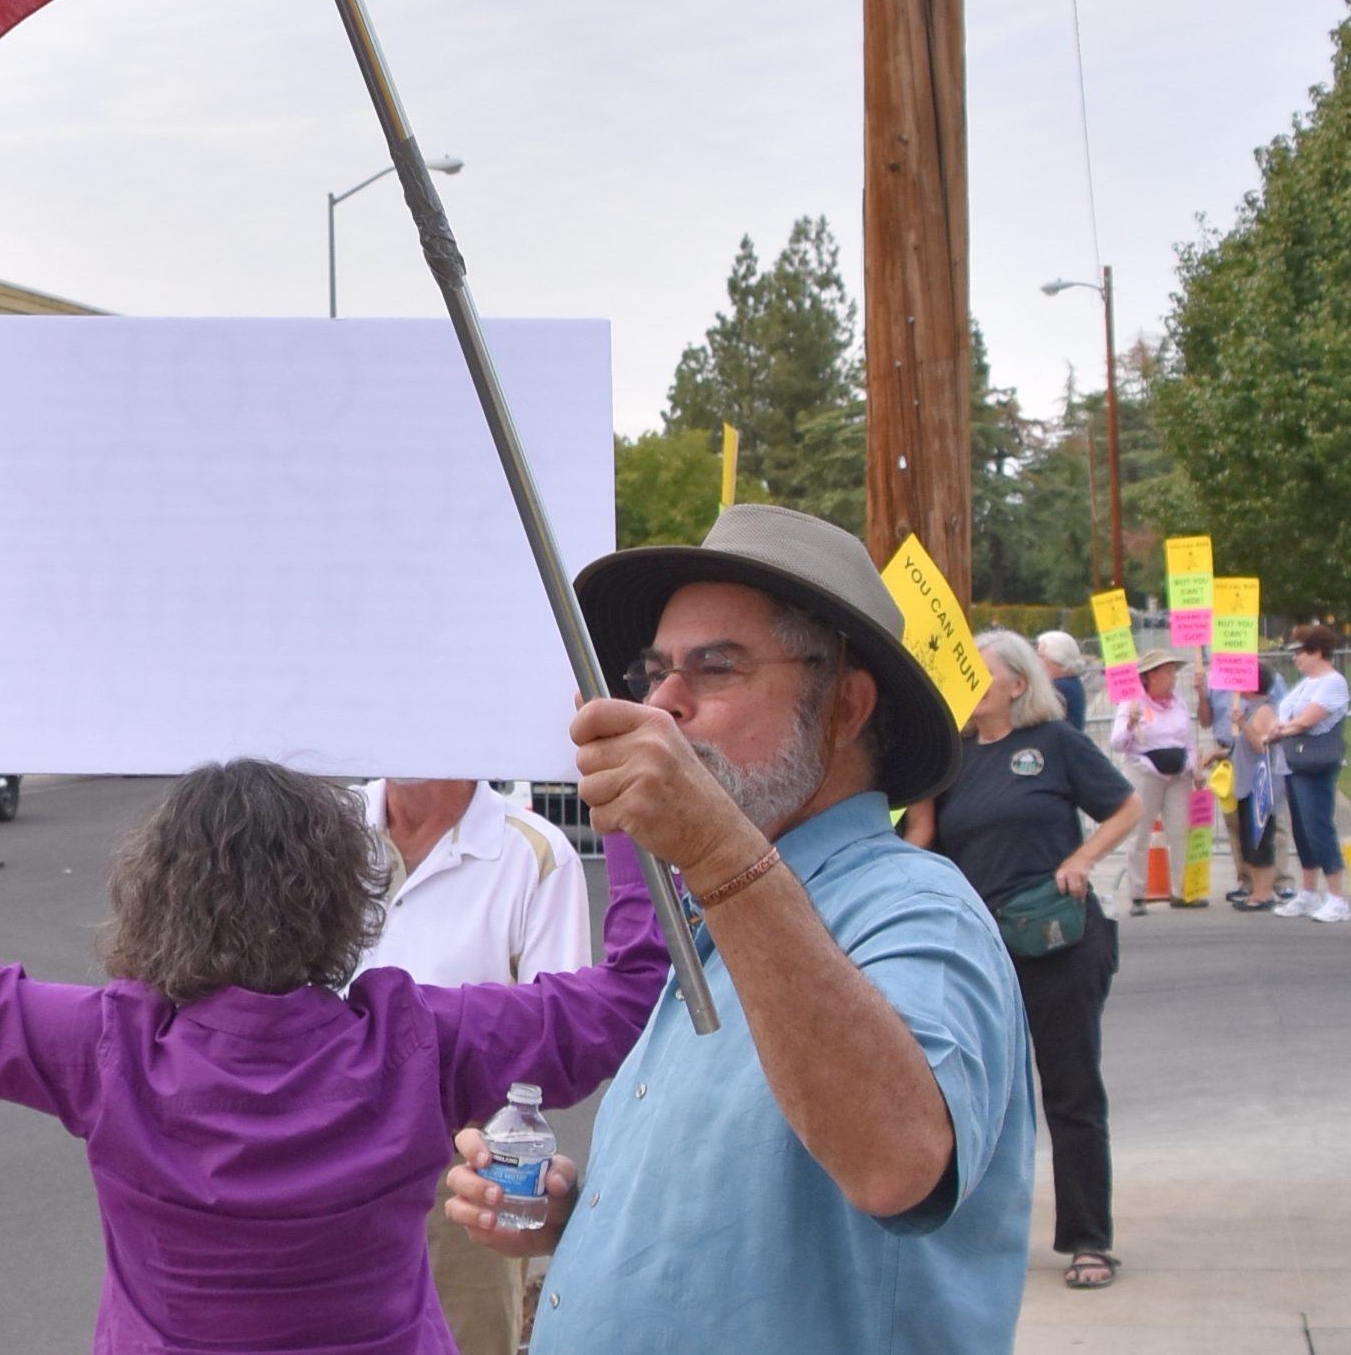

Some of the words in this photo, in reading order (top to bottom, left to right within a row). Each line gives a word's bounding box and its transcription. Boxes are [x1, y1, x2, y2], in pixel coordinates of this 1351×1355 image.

[1174, 578, 1190, 586] BUT
[1193, 577, 1209, 585] YOU
[904, 555, 932, 597] YOU
[931, 597, 955, 639] CAN
[952, 640, 980, 693] RUN
[1217, 620, 1234, 628] BUT
[1237, 620, 1254, 628] YOU
[1223, 629, 1248, 637] CAN'T
